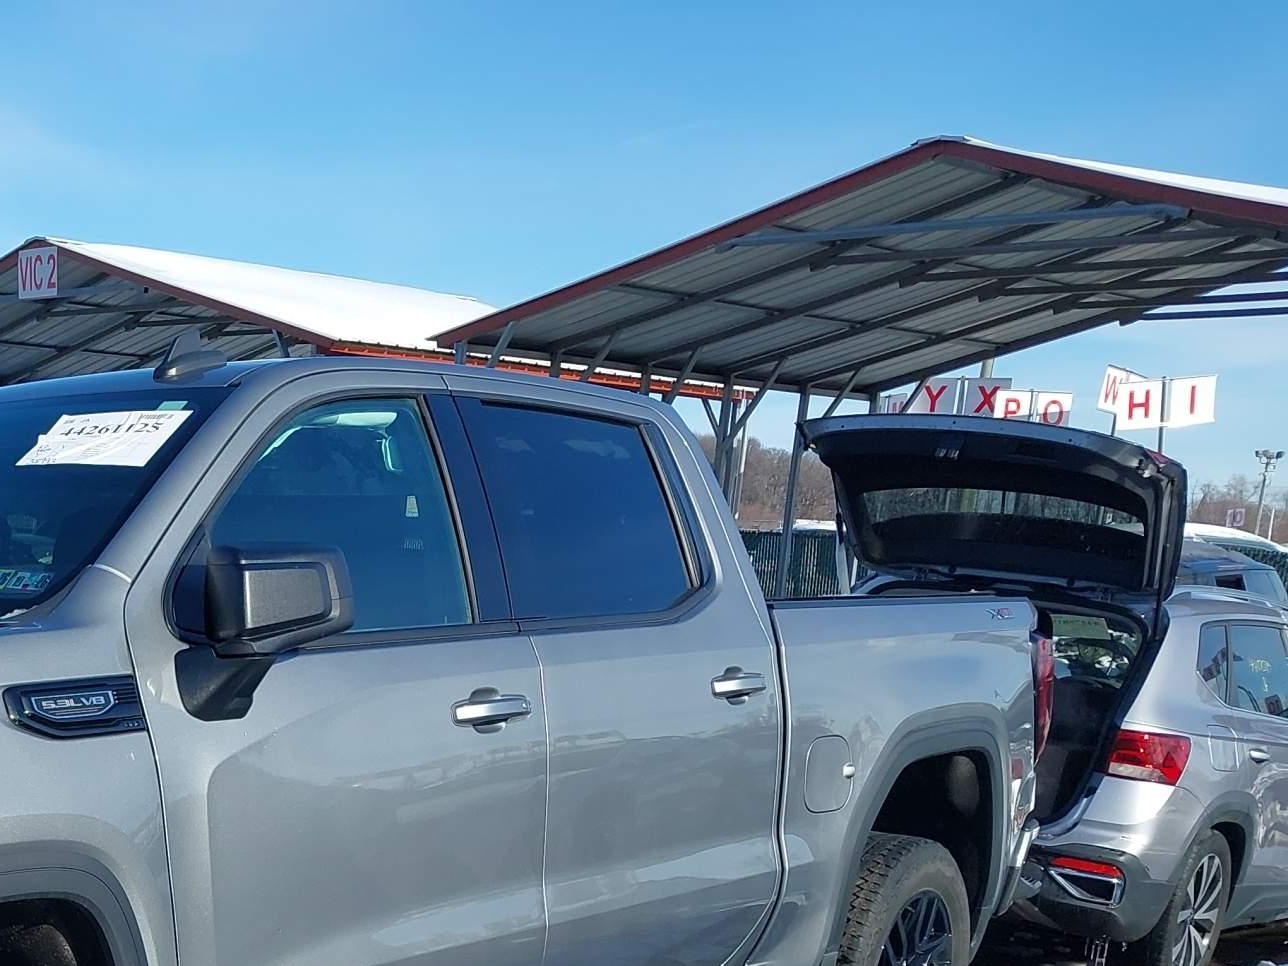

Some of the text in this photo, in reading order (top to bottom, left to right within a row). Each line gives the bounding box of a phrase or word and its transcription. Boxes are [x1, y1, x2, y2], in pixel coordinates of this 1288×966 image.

[19, 254, 57, 291] VIC 2
[925, 385, 948, 413] Y
[973, 385, 1001, 414] X
[1104, 373, 1123, 405] W
[1003, 398, 1021, 420] P
[1128, 389, 1151, 420] H
[59, 422, 165, 437] 44261125
